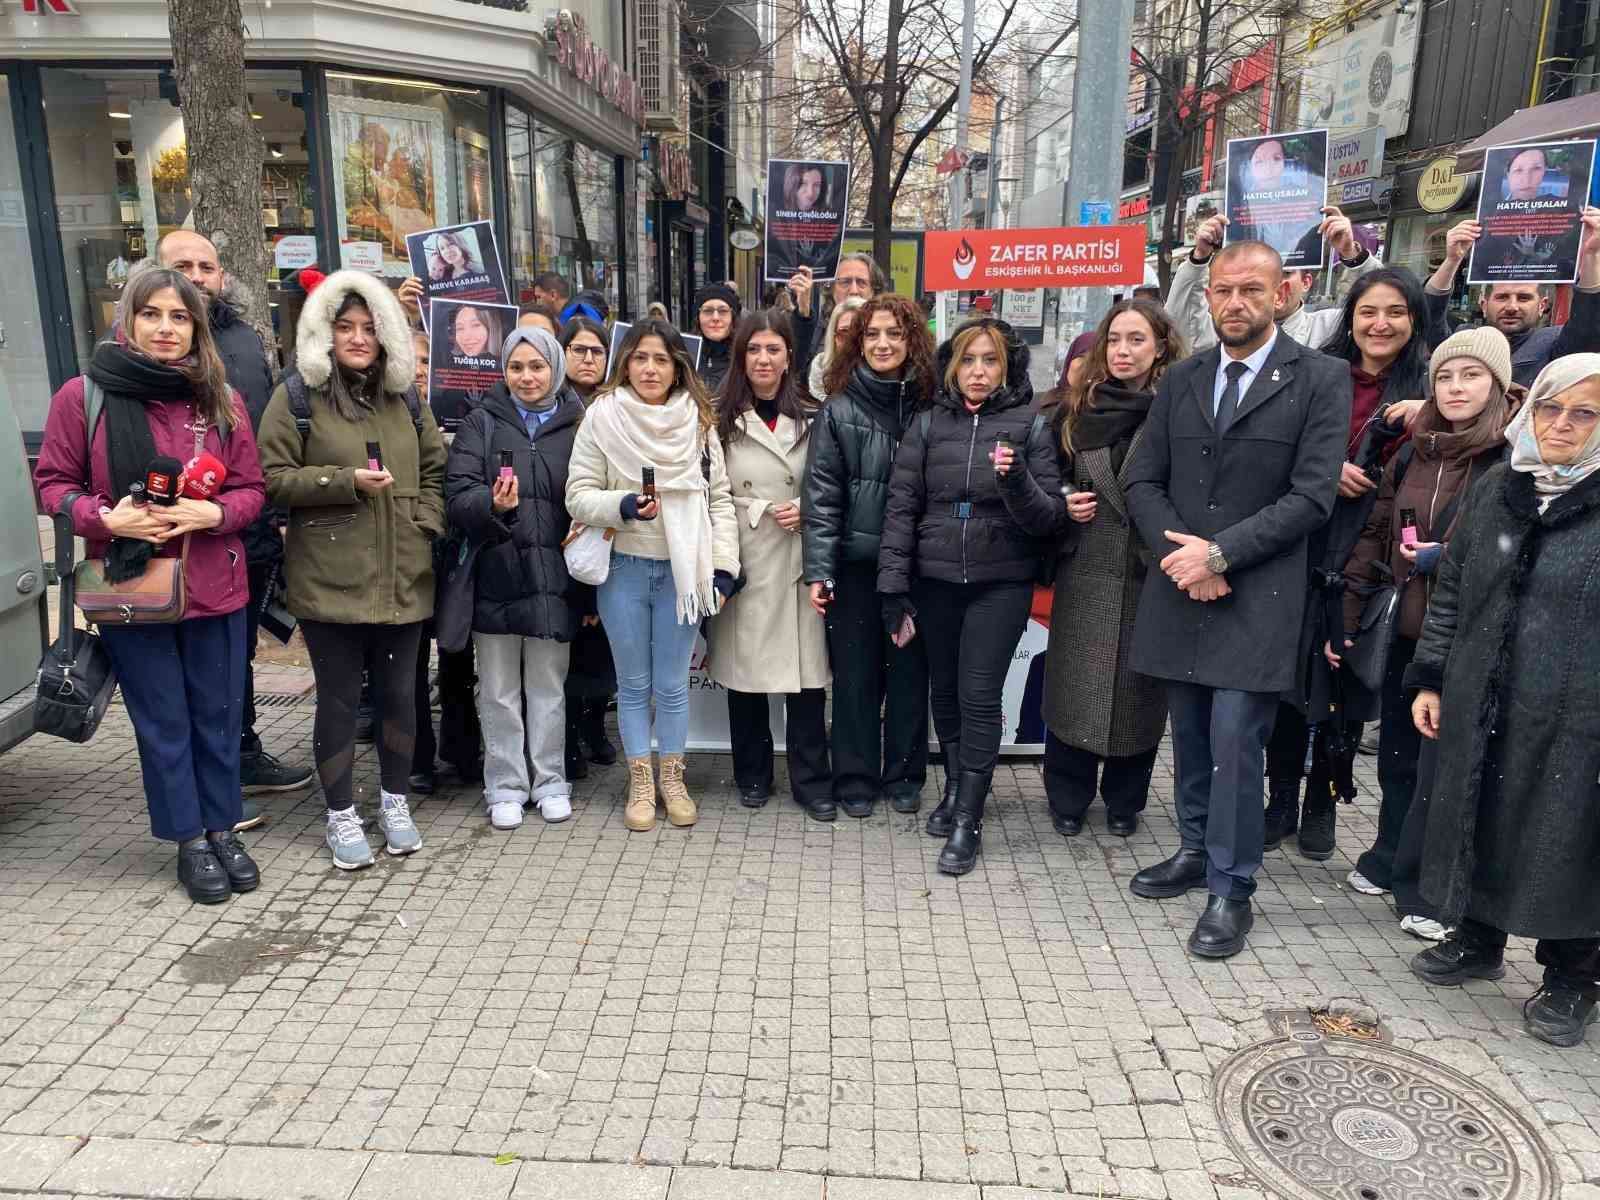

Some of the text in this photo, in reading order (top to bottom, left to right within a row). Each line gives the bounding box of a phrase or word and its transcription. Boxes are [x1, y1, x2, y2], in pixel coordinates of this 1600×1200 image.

[1274, 188, 1309, 198] USALAN
[1344, 184, 1371, 200] CASIO
[1530, 200, 1568, 209] USALAN
[990, 239, 1120, 262] ZAFER PARTİSİ
[985, 263, 1123, 278] ESKİŞEHİR İL BAŞKANLIĞI
[429, 275, 490, 291] MERVE KARABAŞ
[453, 356, 497, 369] TUĞBA KOÇ
